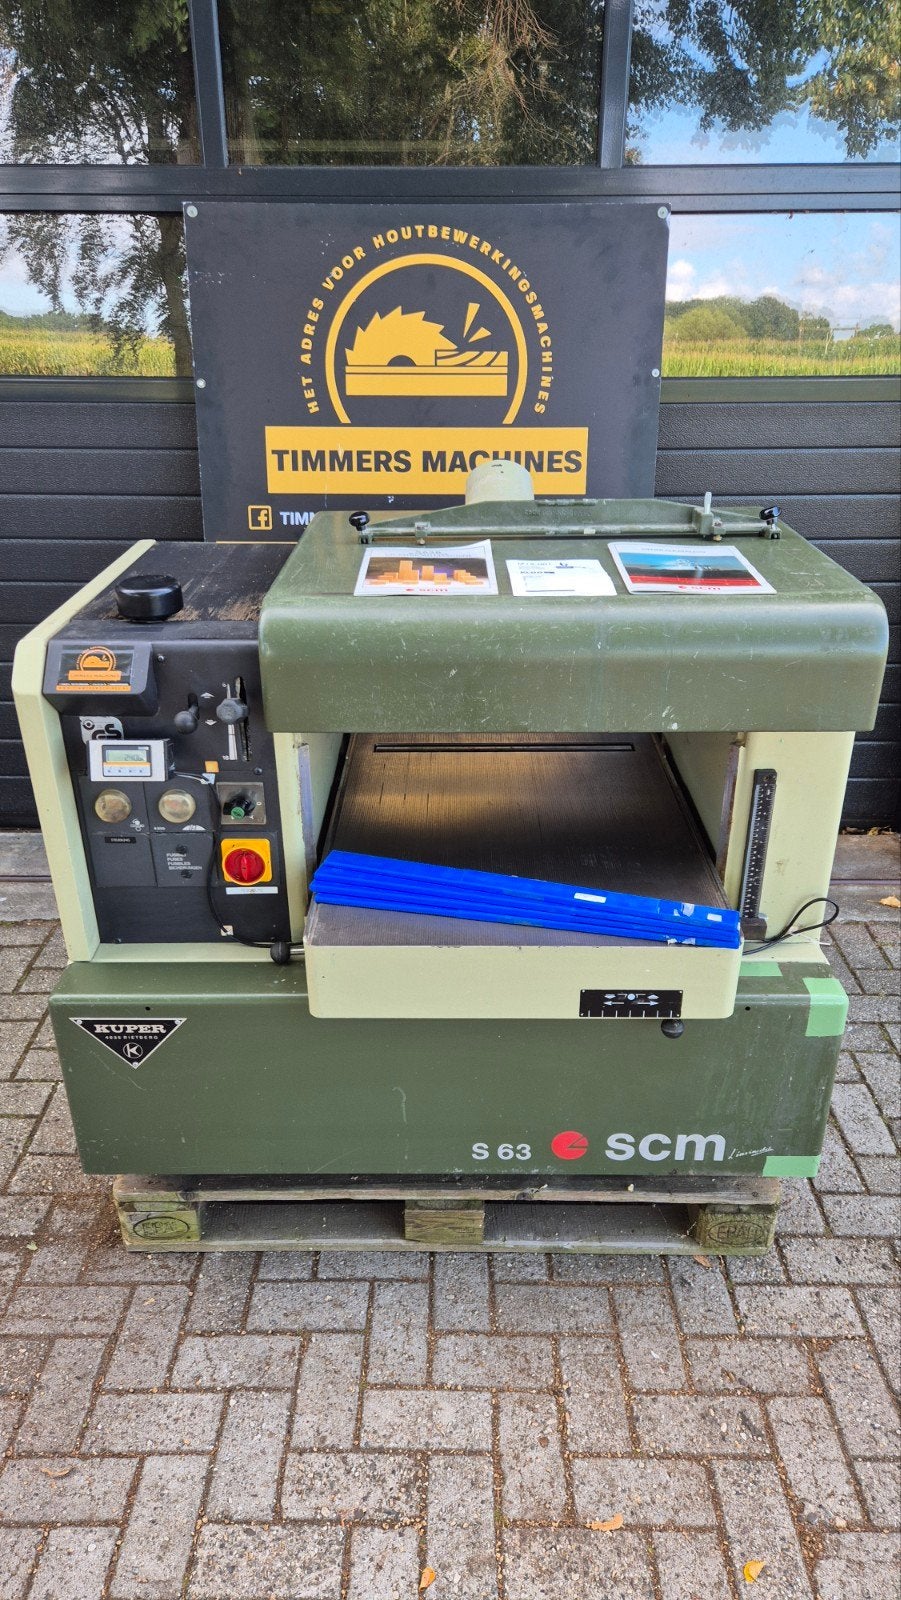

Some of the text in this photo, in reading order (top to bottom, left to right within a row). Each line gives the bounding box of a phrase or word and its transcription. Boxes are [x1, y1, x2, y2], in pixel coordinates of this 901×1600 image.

[301, 224, 554, 414] HET ADRES VOOR HOUTBEWERKINGSMACHINES
[271, 449, 412, 473] TIMMERS
[93, 1024, 167, 1034] KUPER
[471, 1142, 532, 1161] S 63
[605, 1133, 726, 1162] scm
